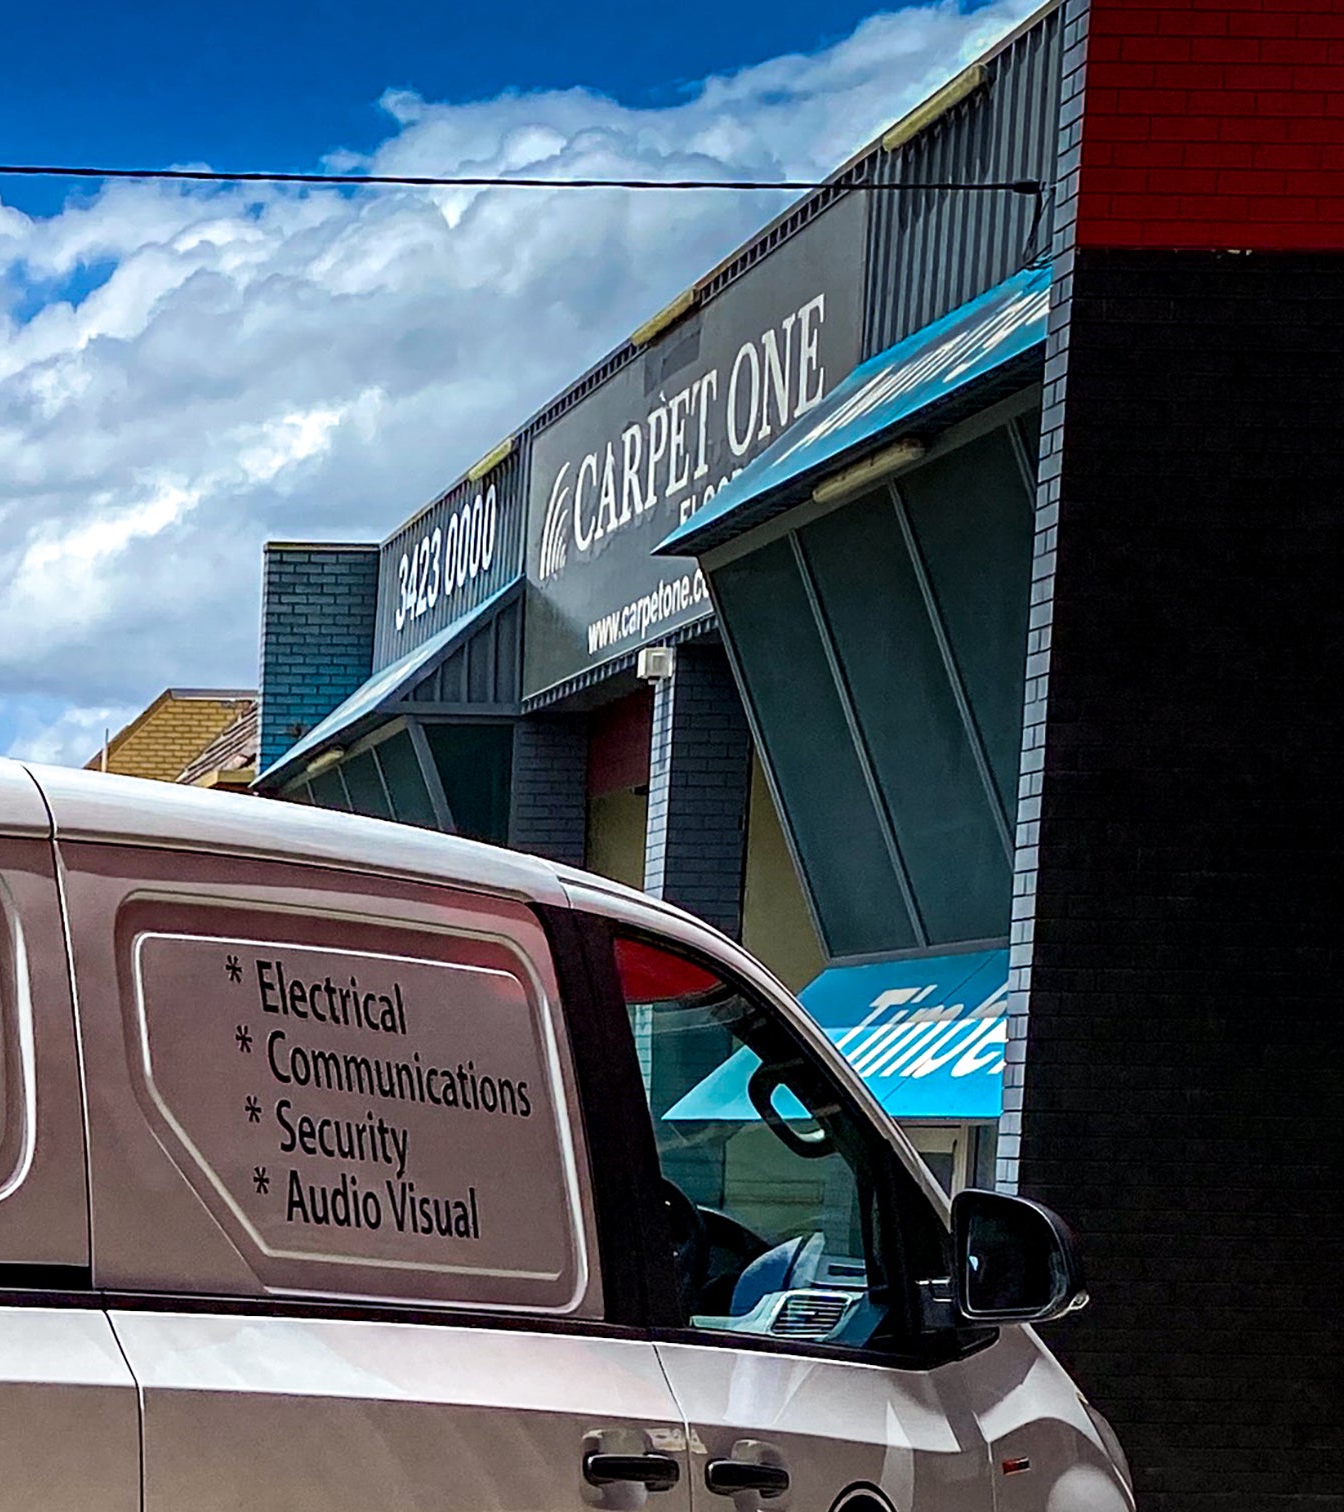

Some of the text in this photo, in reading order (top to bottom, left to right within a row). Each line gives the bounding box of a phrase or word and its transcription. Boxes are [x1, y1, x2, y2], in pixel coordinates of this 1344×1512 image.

[573, 369, 718, 552] CARPET
[726, 292, 825, 457] ONE
[395, 483, 497, 632] 3423 0000
[255, 959, 408, 1035] Electrical
[266, 1030, 532, 1118] Communications
[275, 1099, 409, 1180] Security
[286, 1169, 481, 1240] Audio Visual
